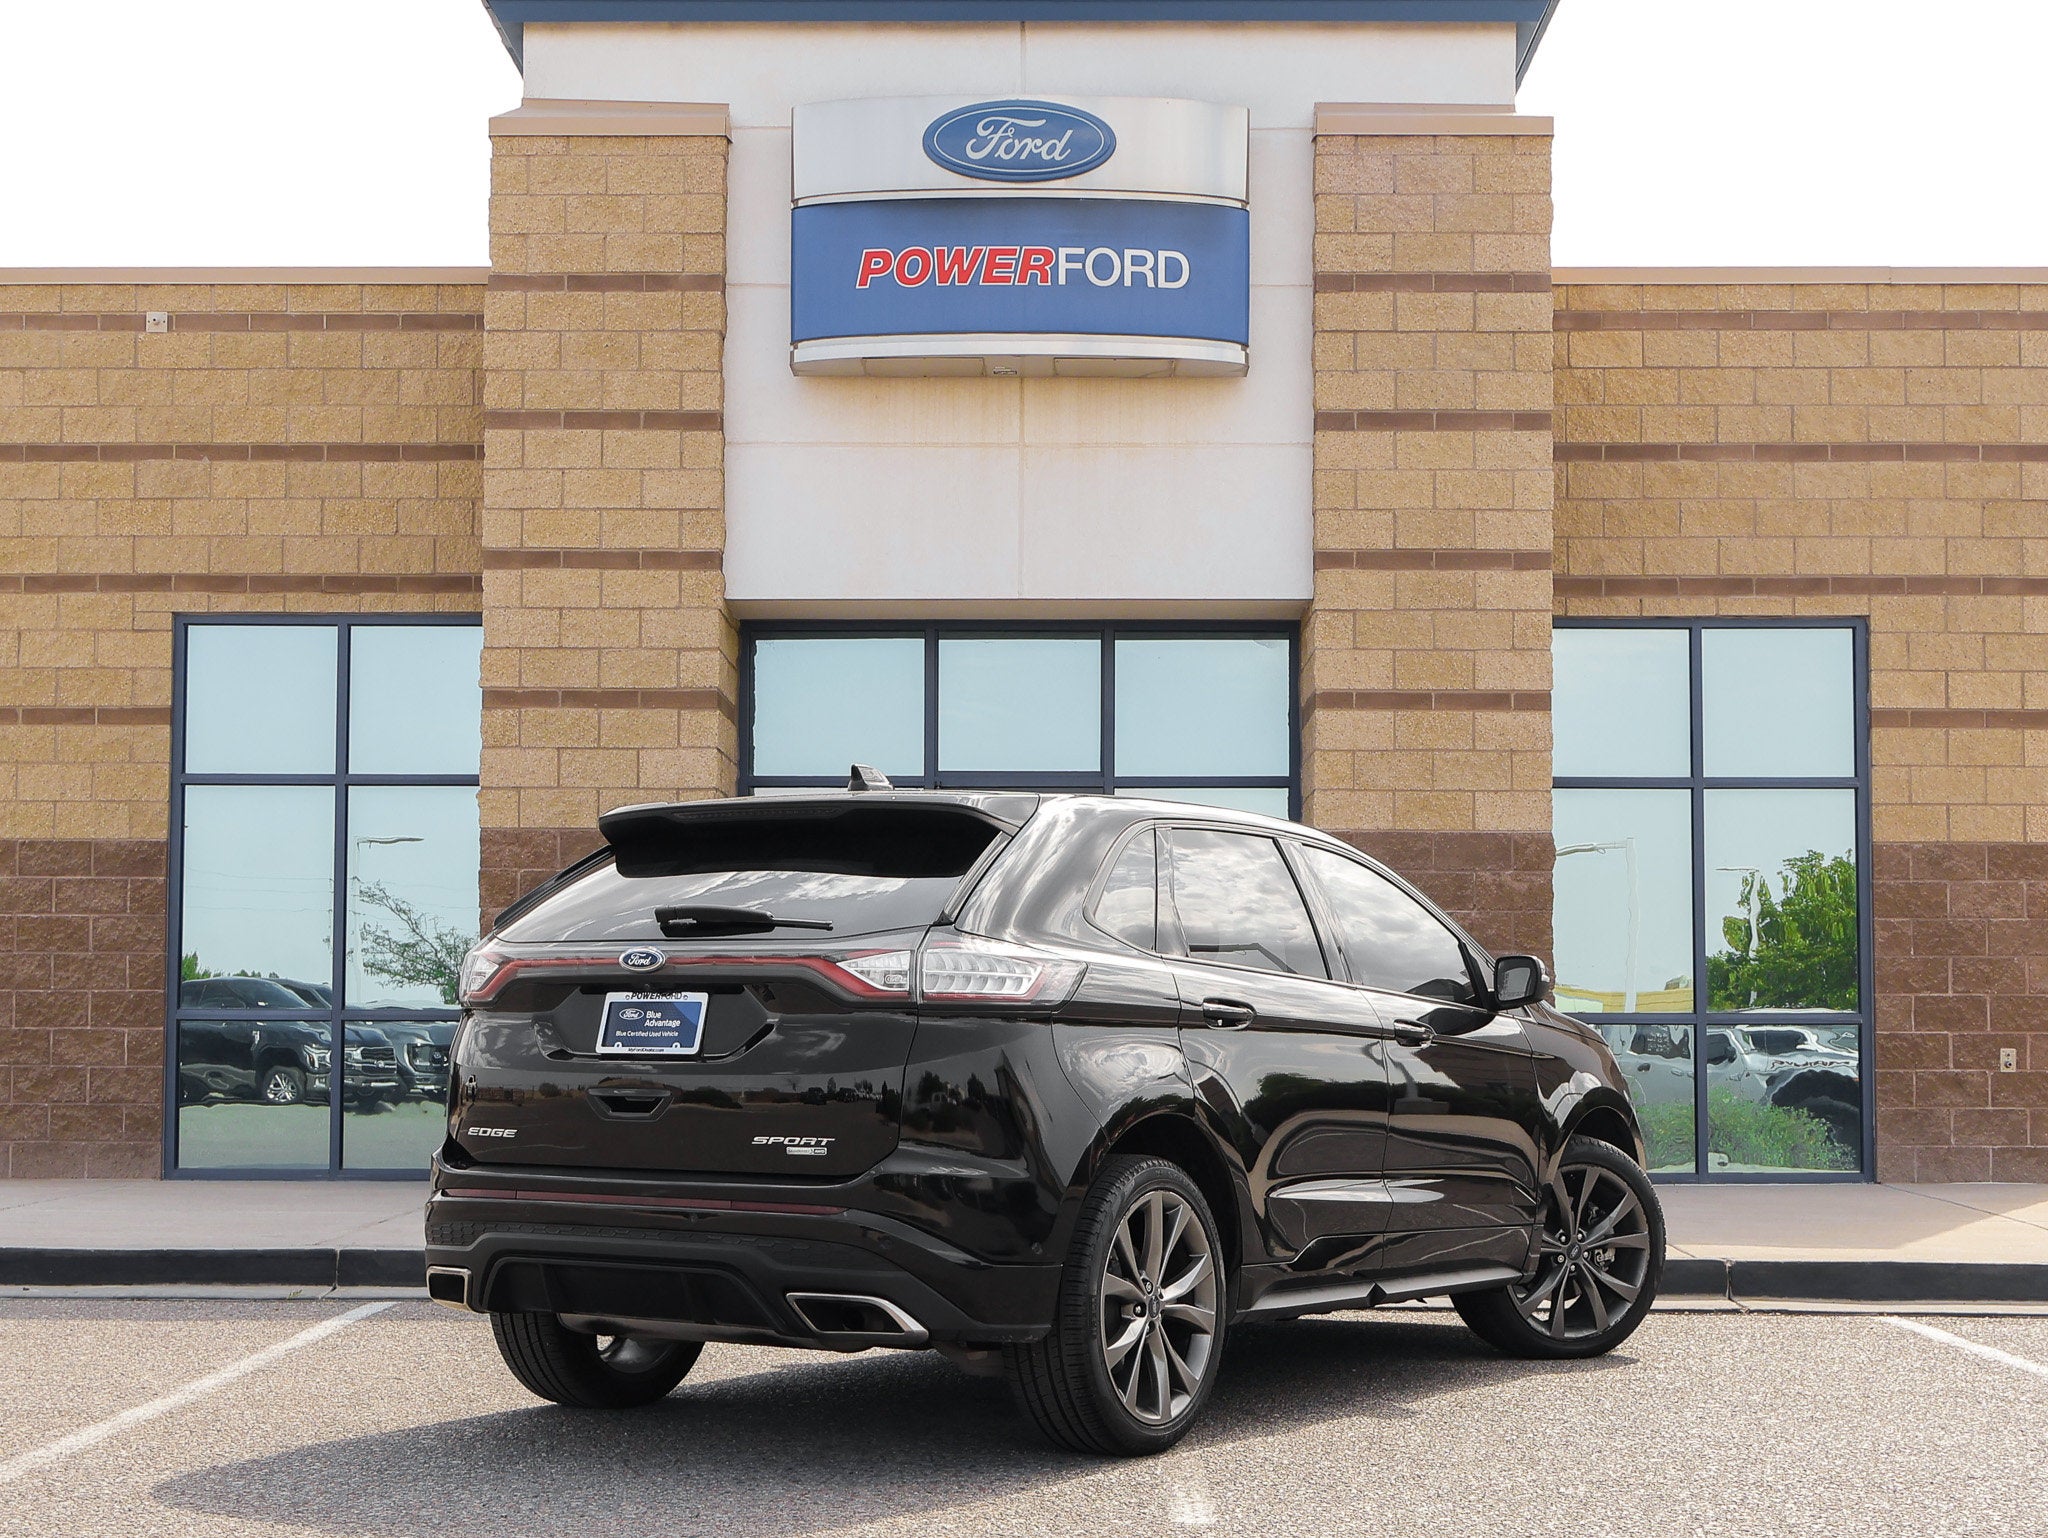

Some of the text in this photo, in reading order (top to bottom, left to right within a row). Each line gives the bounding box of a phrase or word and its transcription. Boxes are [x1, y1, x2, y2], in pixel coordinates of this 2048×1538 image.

[965, 116, 1074, 162] Ford
[628, 953, 652, 966] Ford
[623, 1008, 640, 1018] Ford
[646, 1010, 662, 1019] Blue
[644, 1019, 681, 1028] Advantage
[467, 1126, 518, 1138] EDGE
[751, 1136, 836, 1146] SPORT
